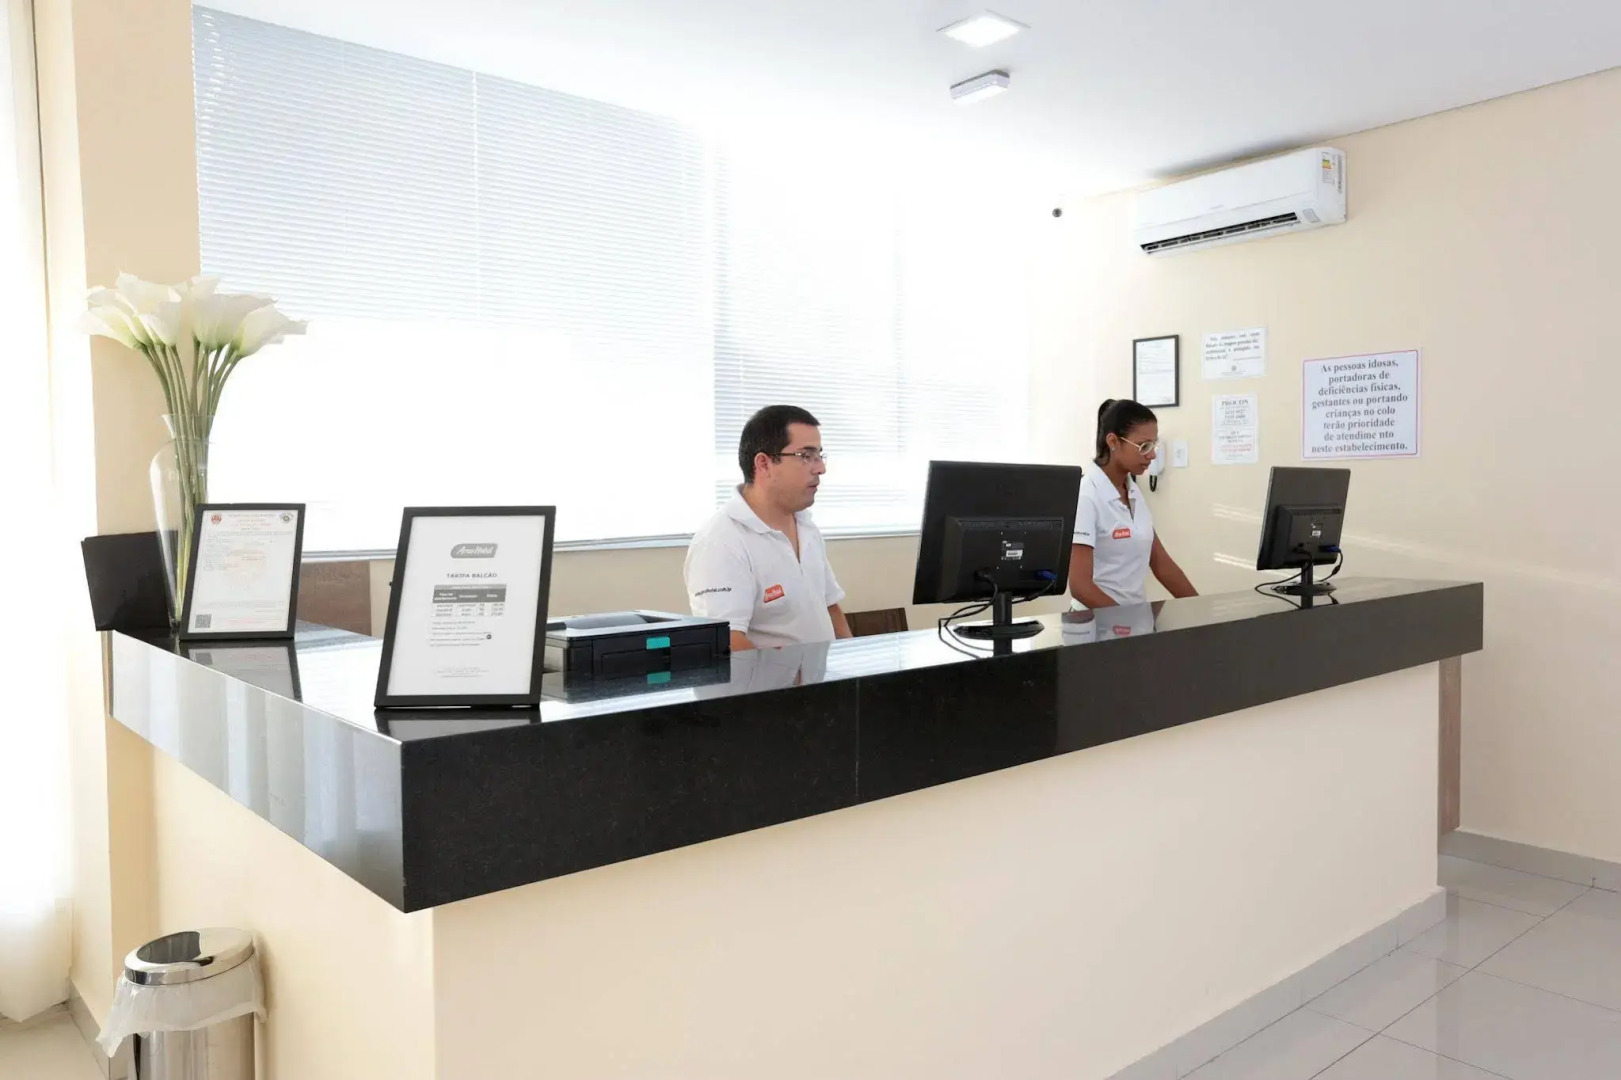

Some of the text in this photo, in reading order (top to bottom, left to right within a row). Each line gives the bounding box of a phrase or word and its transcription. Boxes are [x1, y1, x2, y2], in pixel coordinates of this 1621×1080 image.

[1322, 359, 1399, 374] As pessoas idosas,
[1329, 370, 1390, 386] portadoras de
[1318, 383, 1368, 396] deficiências
[1312, 393, 1408, 410] gestantes ou portando
[1325, 406, 1396, 419] crianças no colo
[1323, 417, 1395, 431] terão prioridade
[1324, 432, 1334, 441] de
[1312, 441, 1408, 453] neste estabelecimento.
